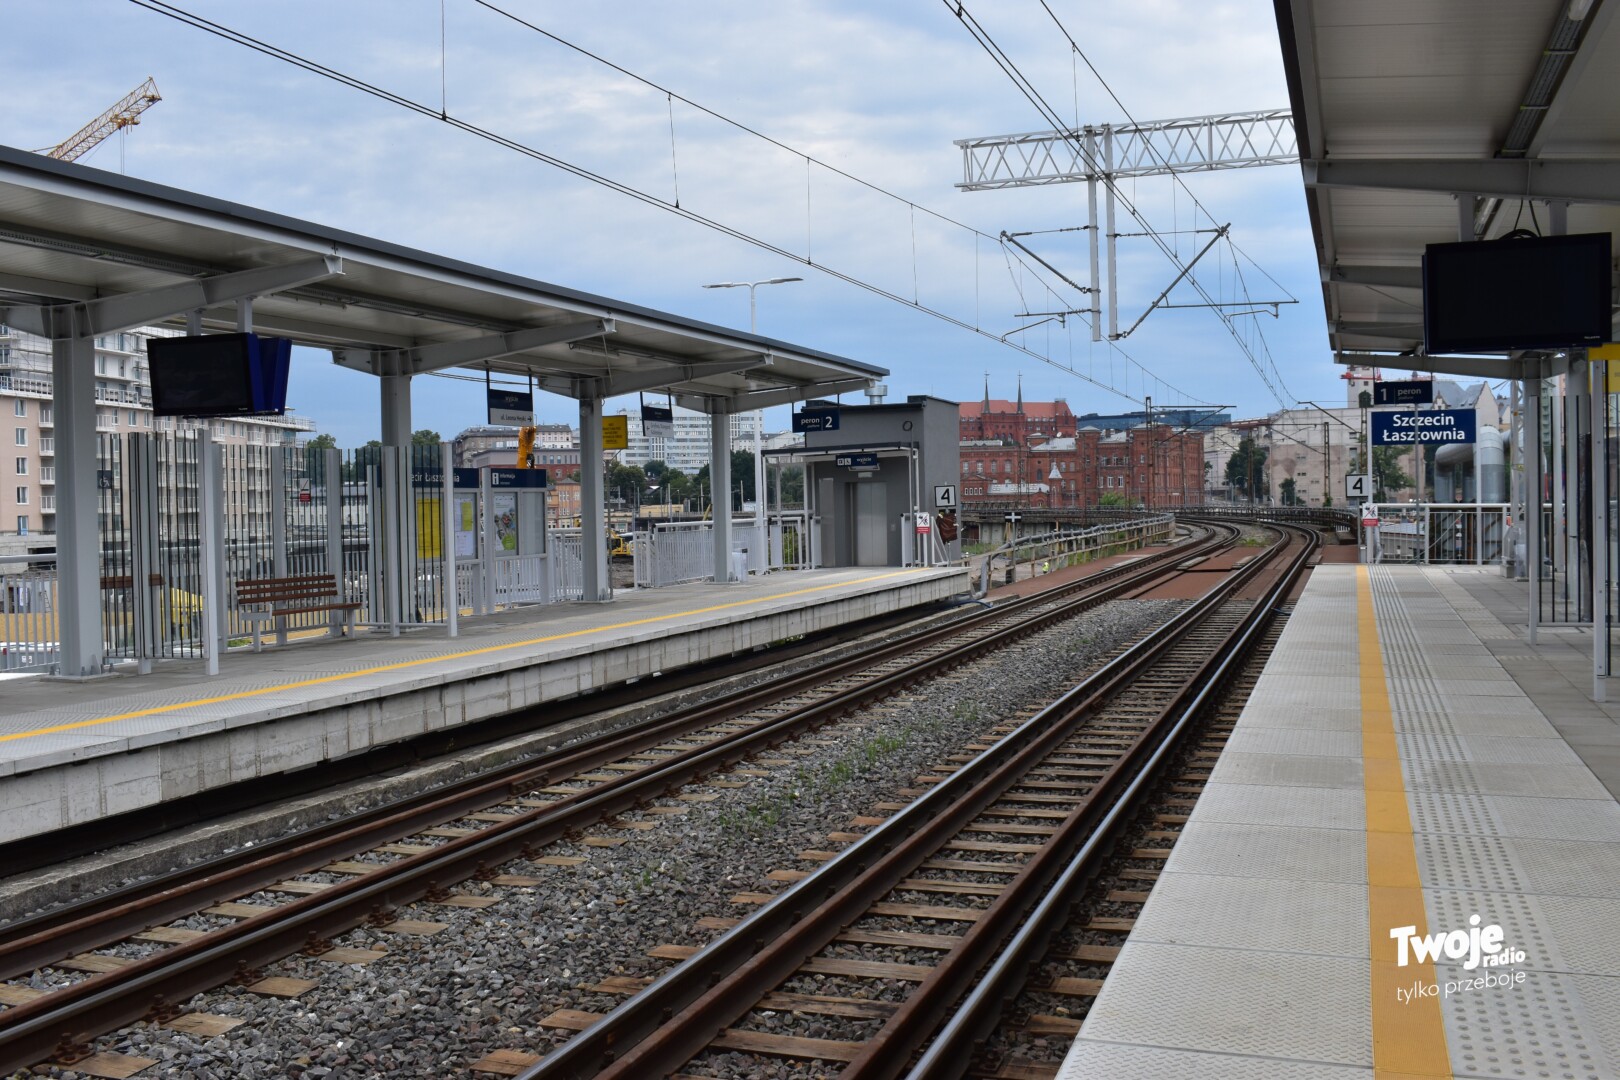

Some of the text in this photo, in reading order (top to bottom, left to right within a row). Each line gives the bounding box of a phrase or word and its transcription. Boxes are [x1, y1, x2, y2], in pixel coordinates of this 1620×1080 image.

[1380, 388, 1422, 401] 1 peron
[800, 416, 833, 428] peron 2
[1393, 413, 1454, 427] Szczecin
[1352, 477, 1363, 494] 4
[941, 488, 950, 504] 4
